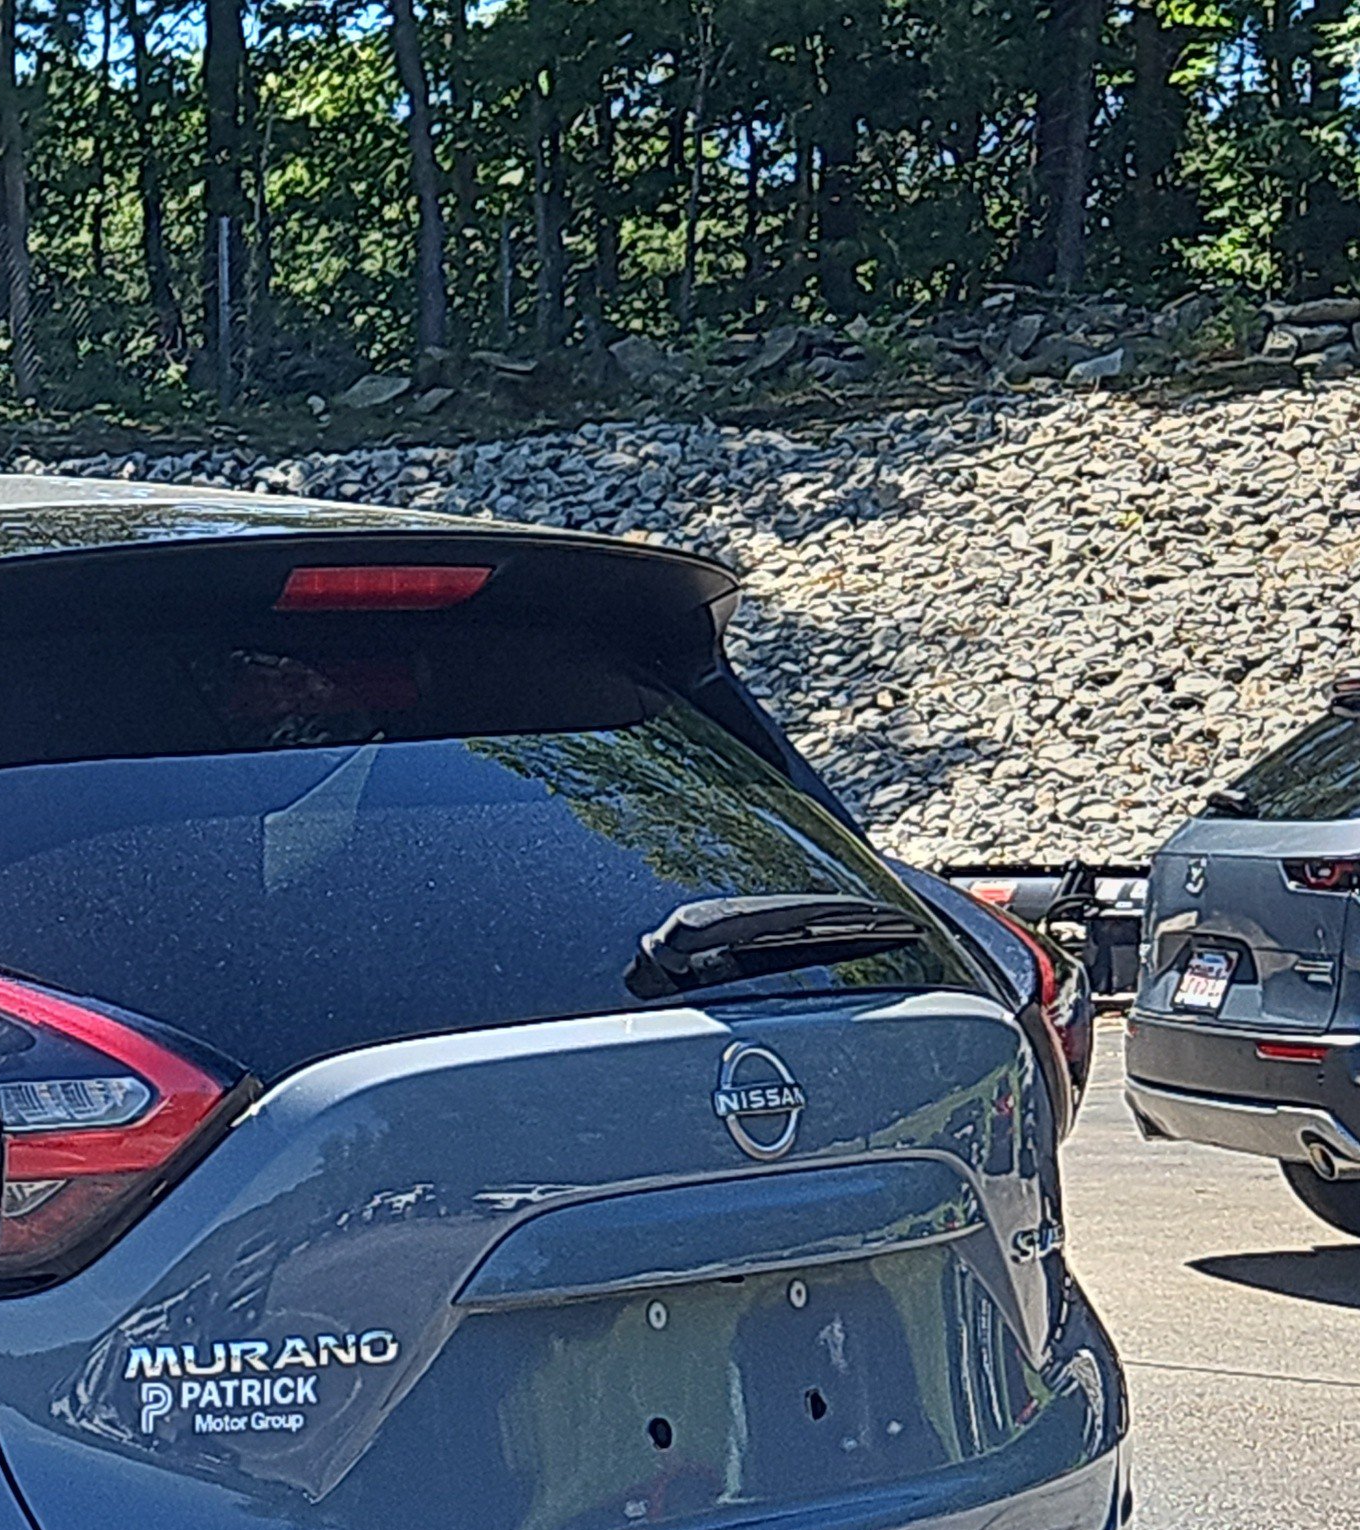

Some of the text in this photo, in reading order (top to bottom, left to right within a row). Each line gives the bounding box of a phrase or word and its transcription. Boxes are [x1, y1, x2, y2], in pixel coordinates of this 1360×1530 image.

[716, 1087, 805, 1112] NISSAN
[124, 1330, 398, 1379] MURANO
[181, 1375, 317, 1408] PATRICK
[195, 1411, 305, 1433] Motor Group
